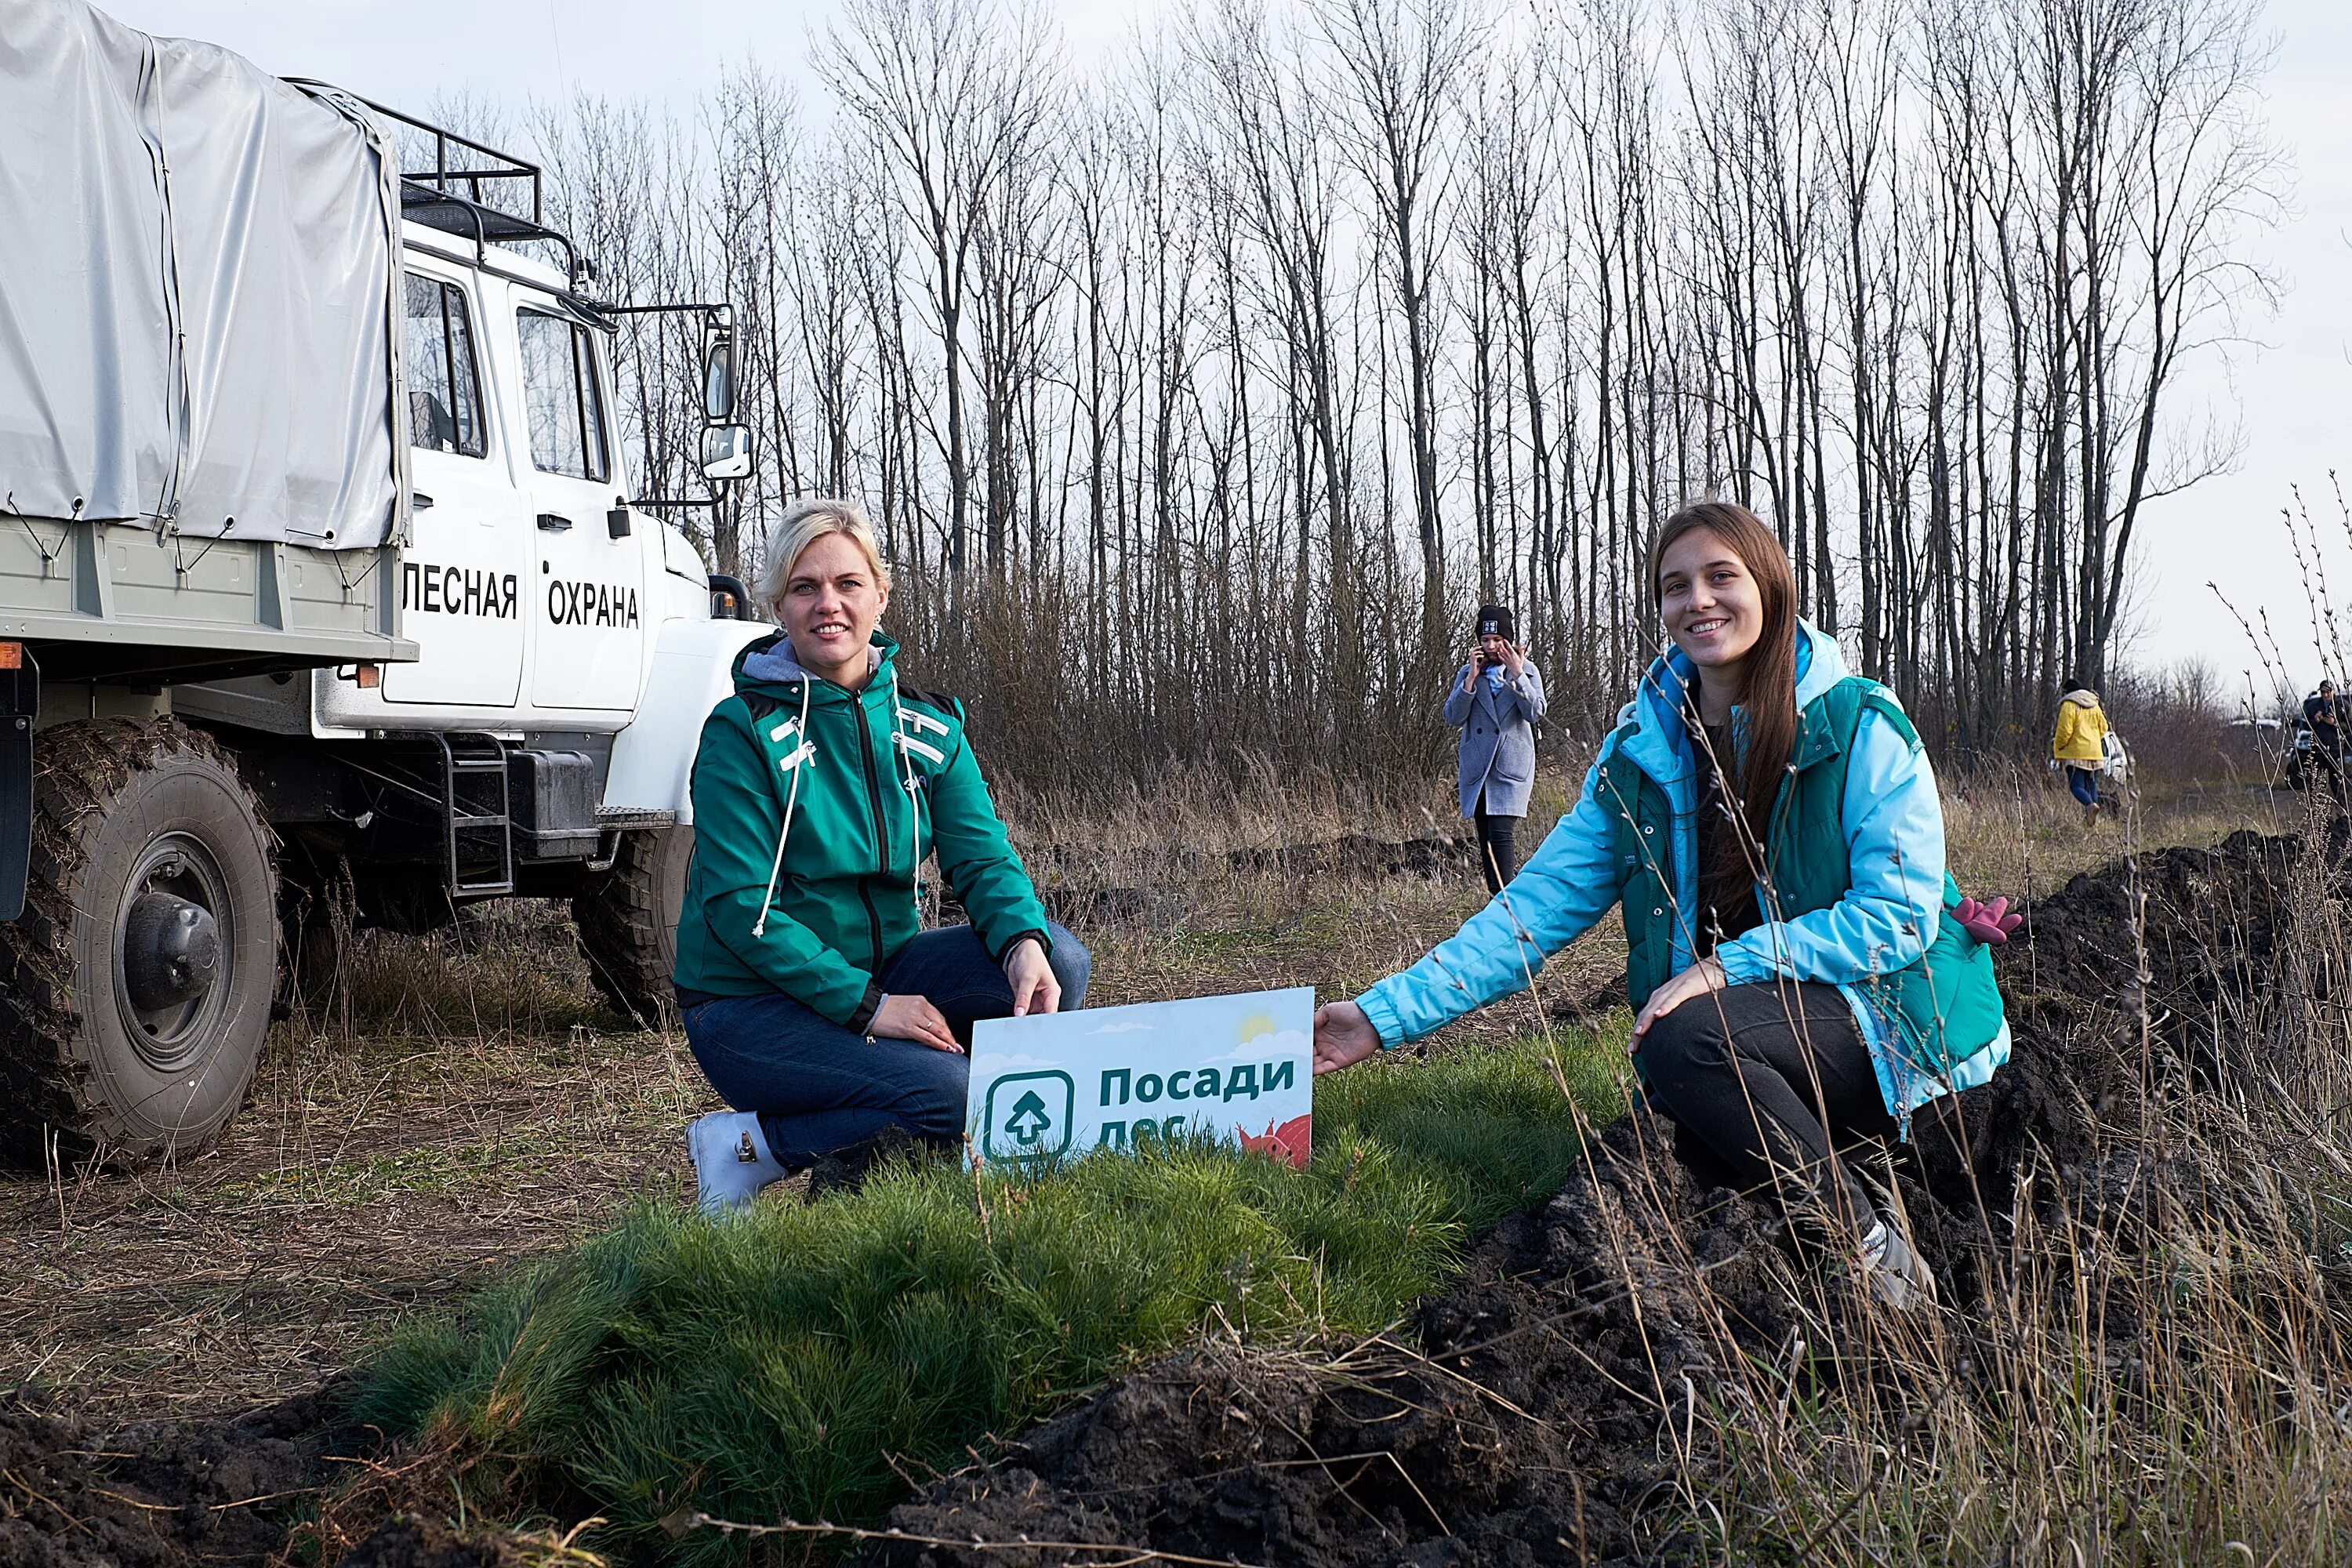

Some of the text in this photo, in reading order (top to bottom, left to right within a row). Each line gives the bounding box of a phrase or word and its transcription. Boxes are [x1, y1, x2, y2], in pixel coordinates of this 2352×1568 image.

[402, 562, 639, 630] ЛЕСНАЯ ОХРАНА
[1099, 1060, 1294, 1107] Посади
